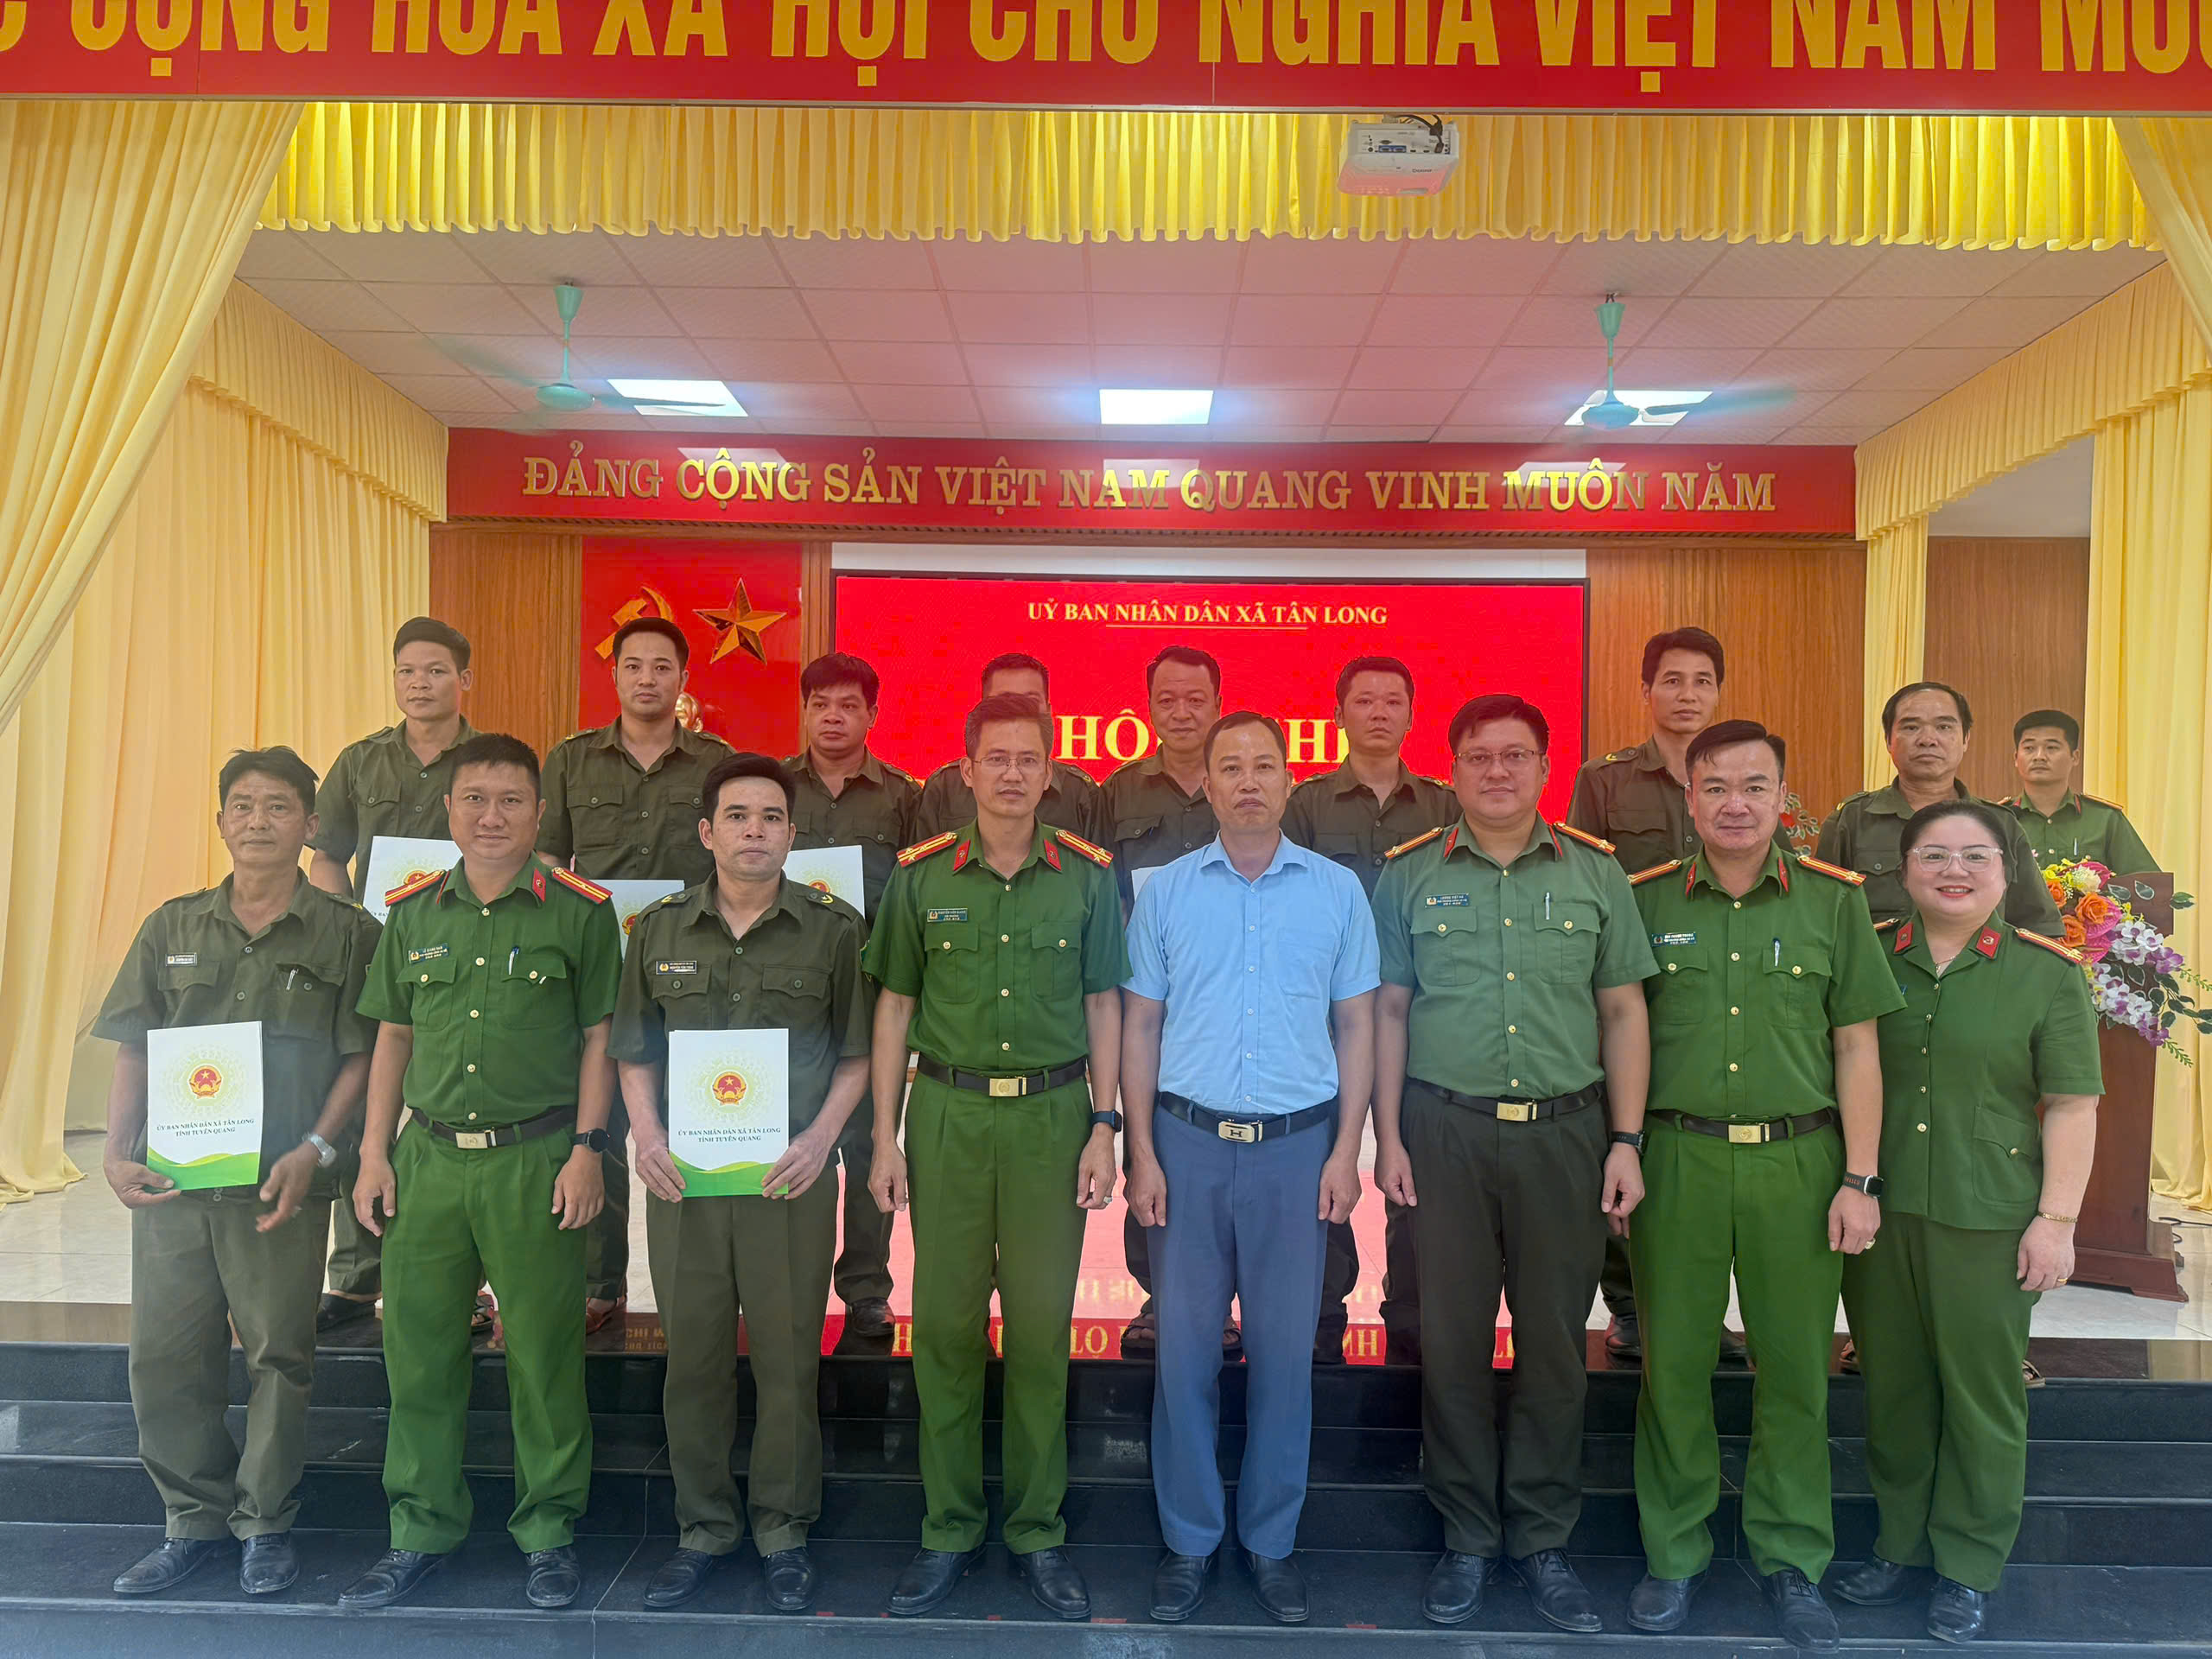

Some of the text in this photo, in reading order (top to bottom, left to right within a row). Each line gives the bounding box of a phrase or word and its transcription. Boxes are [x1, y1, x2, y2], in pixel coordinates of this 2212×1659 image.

[523, 441, 1777, 515] ĐẢNG CỘNG SẢN VIỆT NAM QUANG VINH MUÔN NĂM
[1064, 603, 1109, 621] BAN
[1115, 599, 1178, 622] NHÂN
[1184, 600, 1230, 622] DÂN
[1236, 601, 1268, 623] XÃ
[1272, 601, 1318, 623] TÂN
[1324, 606, 1389, 625] LONG
